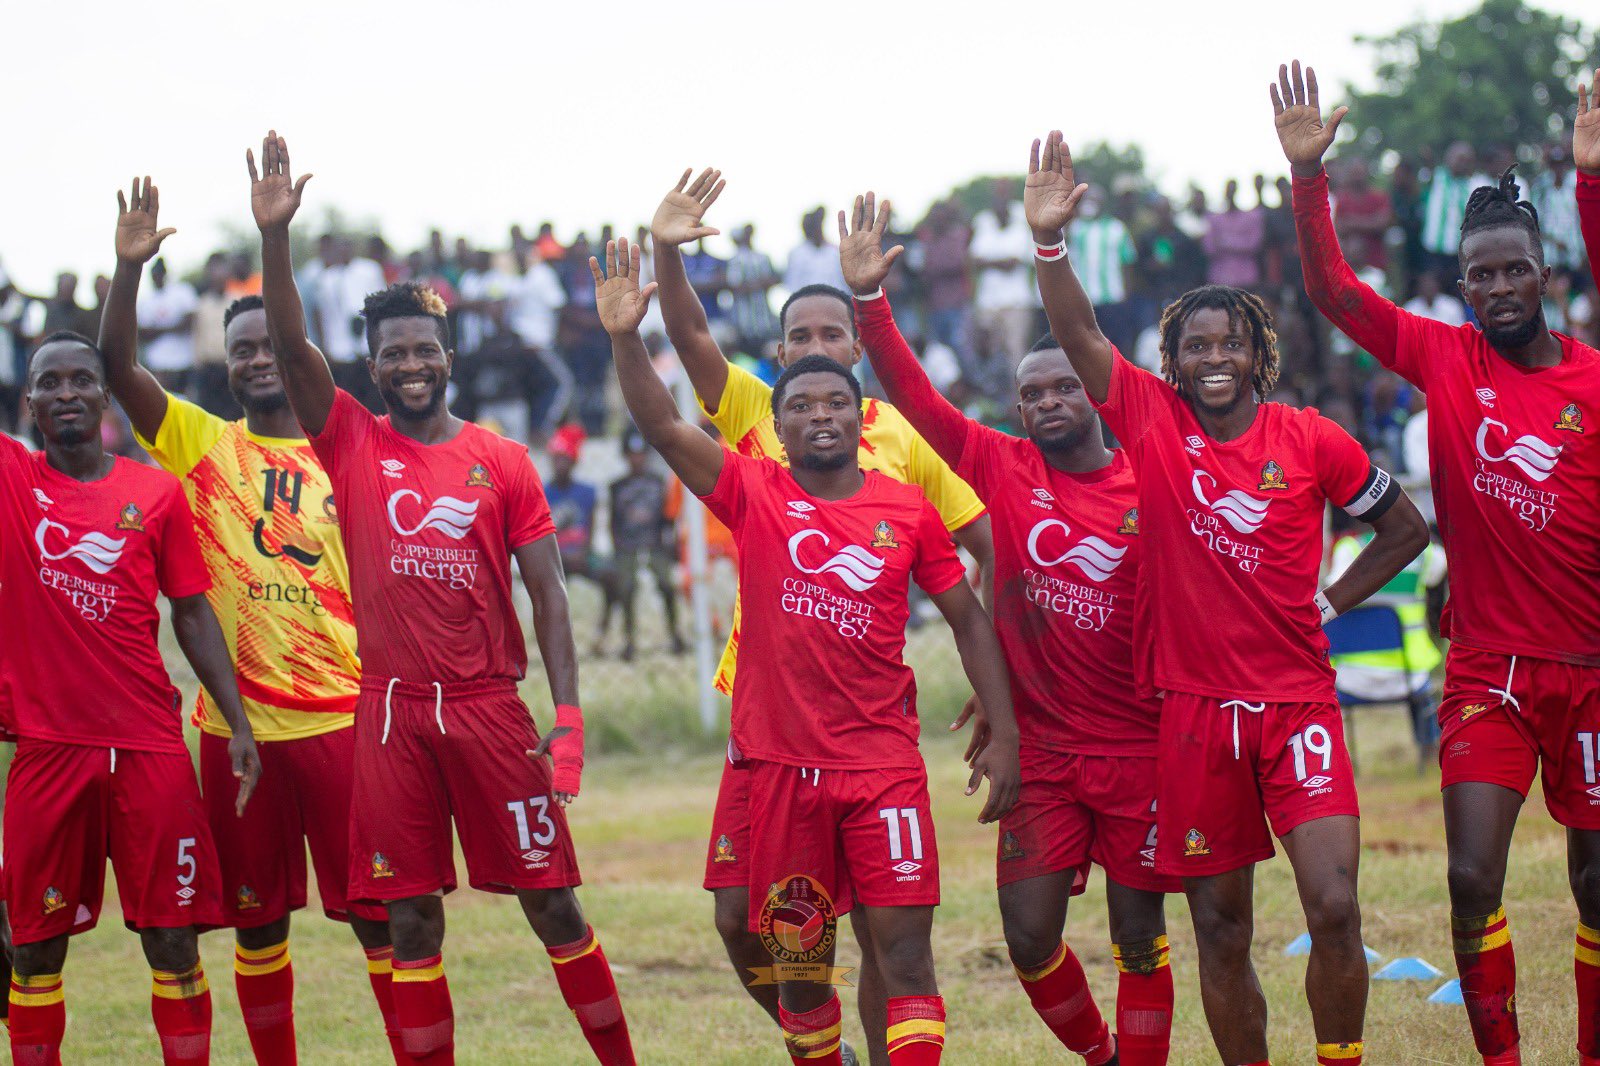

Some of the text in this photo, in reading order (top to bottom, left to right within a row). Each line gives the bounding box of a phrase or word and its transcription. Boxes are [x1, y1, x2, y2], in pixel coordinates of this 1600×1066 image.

[261, 468, 303, 514] 14
[1030, 499, 1053, 511] umbro
[1473, 473, 1557, 532] enrgy
[786, 510, 811, 521] umbro
[390, 555, 479, 590] energy
[391, 539, 478, 562] COPPERBELT
[783, 577, 875, 618] COPPERBELT
[1023, 568, 1118, 606] COPPERBELT
[1025, 584, 1115, 632] energy
[781, 593, 873, 639] energy
[1286, 724, 1332, 782] 19
[1577, 732, 1600, 784] 1
[1308, 787, 1333, 797] umbro
[507, 795, 556, 850] 13
[879, 808, 923, 860] 11
[176, 838, 197, 886] 5
[525, 861, 550, 869] umbro
